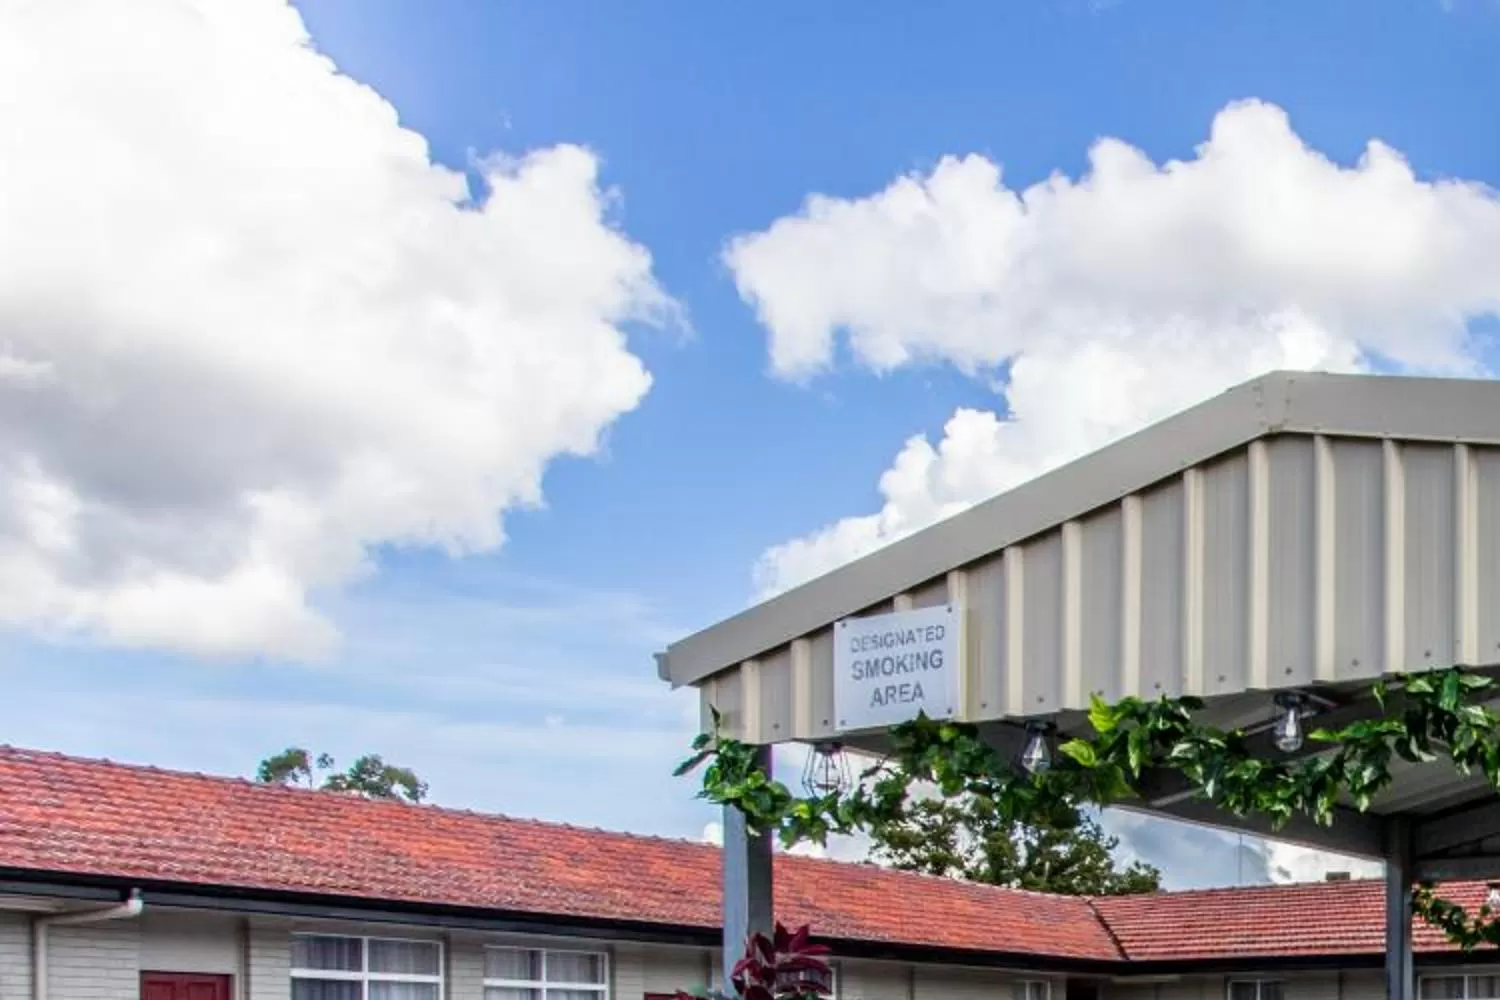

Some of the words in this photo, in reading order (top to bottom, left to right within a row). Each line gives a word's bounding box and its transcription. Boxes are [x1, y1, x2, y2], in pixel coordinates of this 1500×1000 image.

[851, 625, 945, 653] DESIGNATED
[851, 650, 943, 680] SMOKING
[870, 681, 924, 707] AREA
